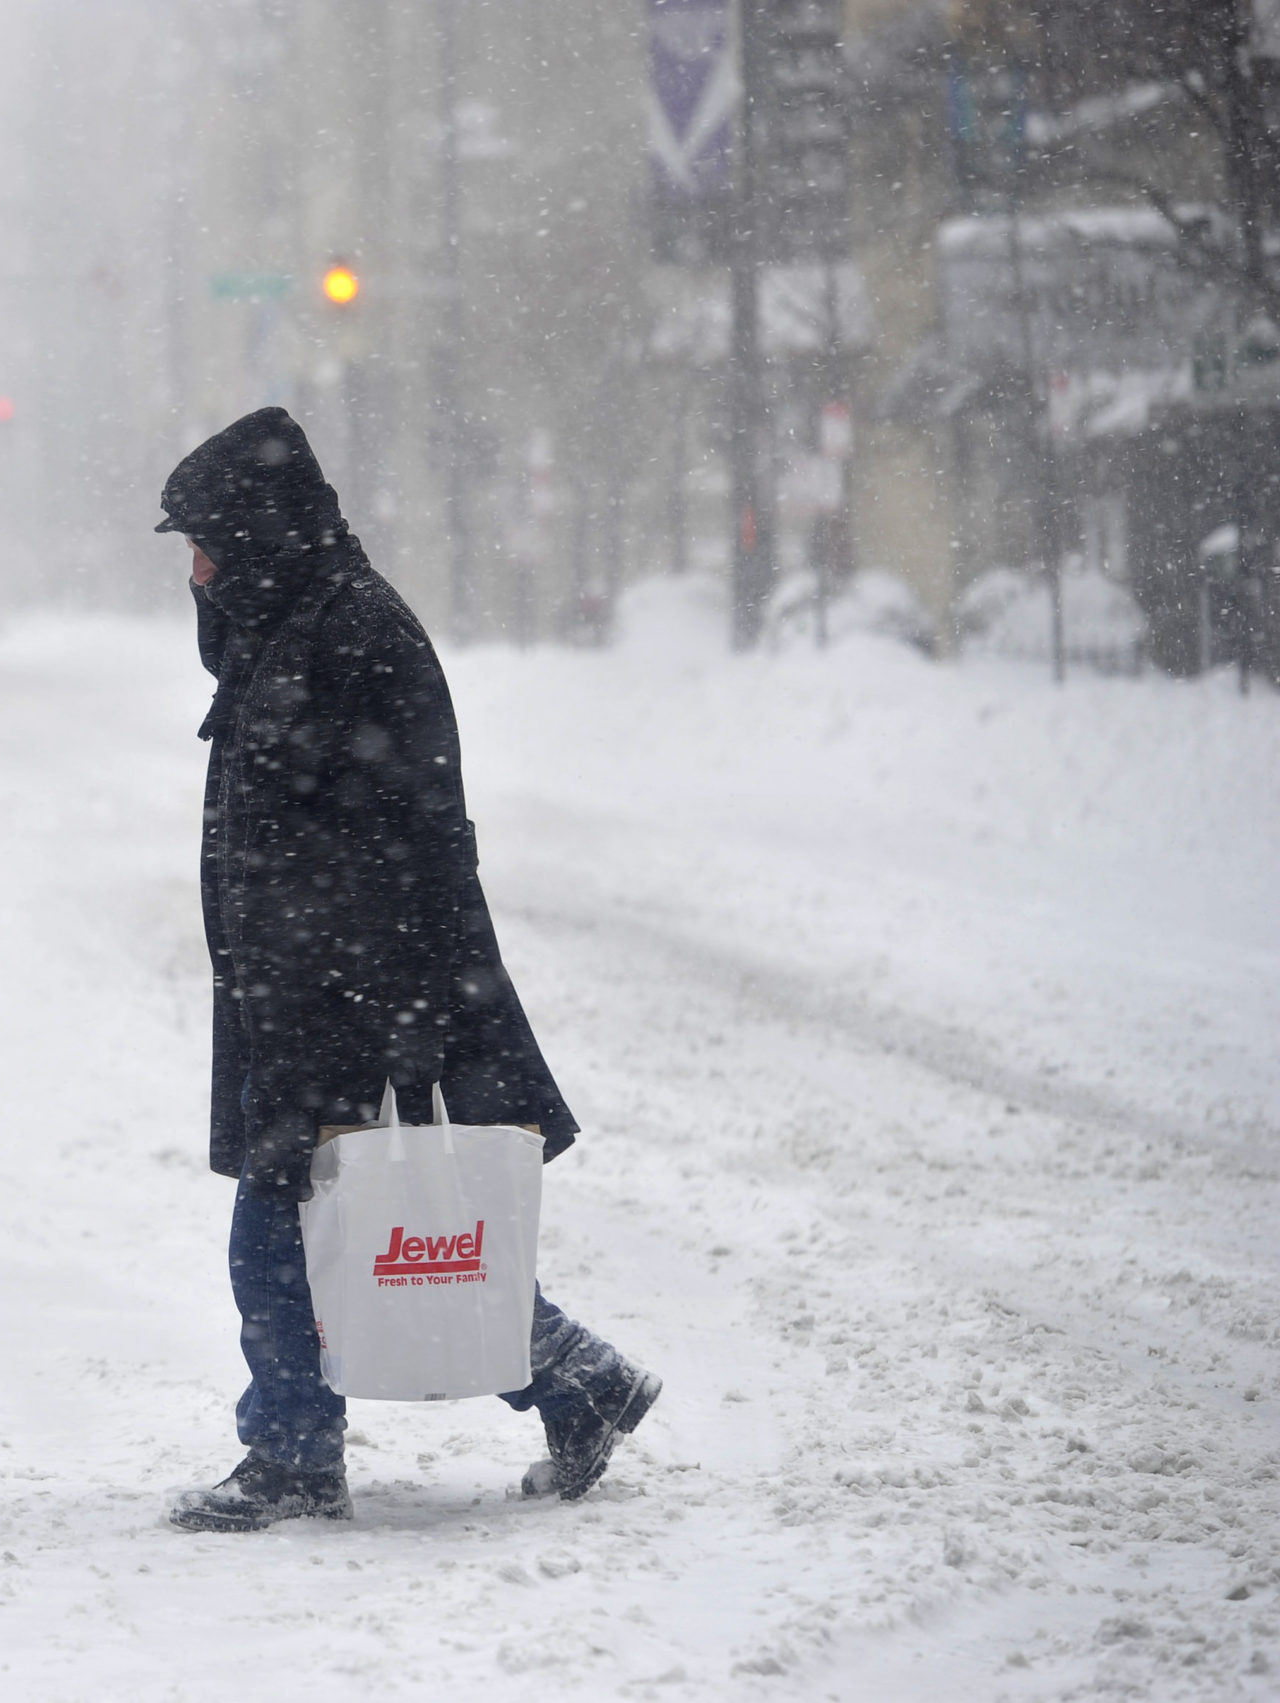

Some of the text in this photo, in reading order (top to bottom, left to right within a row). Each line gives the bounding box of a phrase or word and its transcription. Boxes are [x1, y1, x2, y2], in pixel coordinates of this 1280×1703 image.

[375, 1220, 485, 1263] Jewel
[378, 1276, 408, 1287] Fresh
[411, 1276, 424, 1286] to
[426, 1275, 454, 1285] Your
